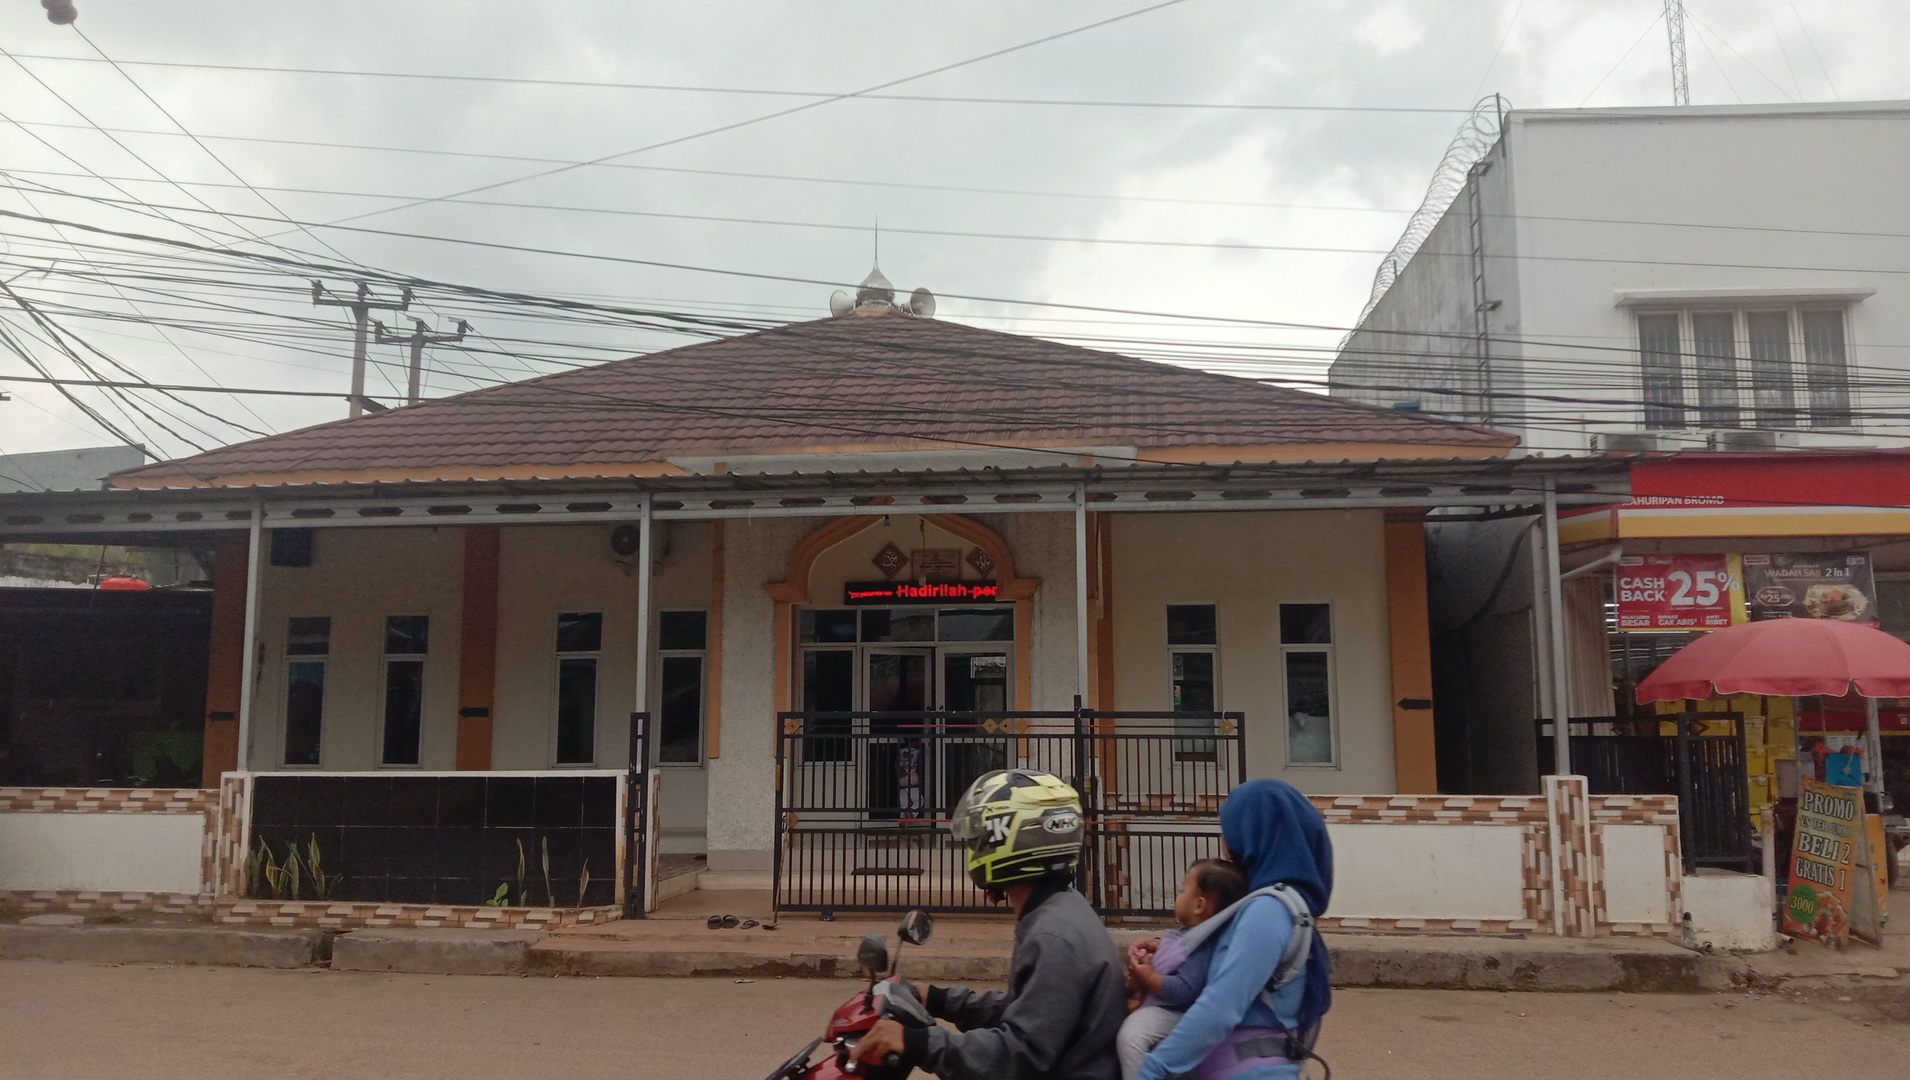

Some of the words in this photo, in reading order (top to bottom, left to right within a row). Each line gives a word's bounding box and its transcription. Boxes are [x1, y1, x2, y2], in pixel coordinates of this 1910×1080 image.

[1622, 496, 1682, 505] AHURIPAN
[1685, 495, 1725, 505] BROMO
[1764, 569, 1802, 577] WADAH
[1825, 568, 1832, 576] 2
[1844, 568, 1850, 576] 1
[1620, 578, 1665, 588] CASH
[1668, 570, 1741, 607] 25%
[1621, 619, 1651, 627] BESAR
[1803, 792, 1853, 820] PROMO
[1798, 831, 1840, 861] BELI
[1841, 844, 1851, 864] 2
[1796, 858, 1835, 886] GRATIS
[1839, 869, 1846, 891] 1
[1790, 895, 1815, 914] 3000
